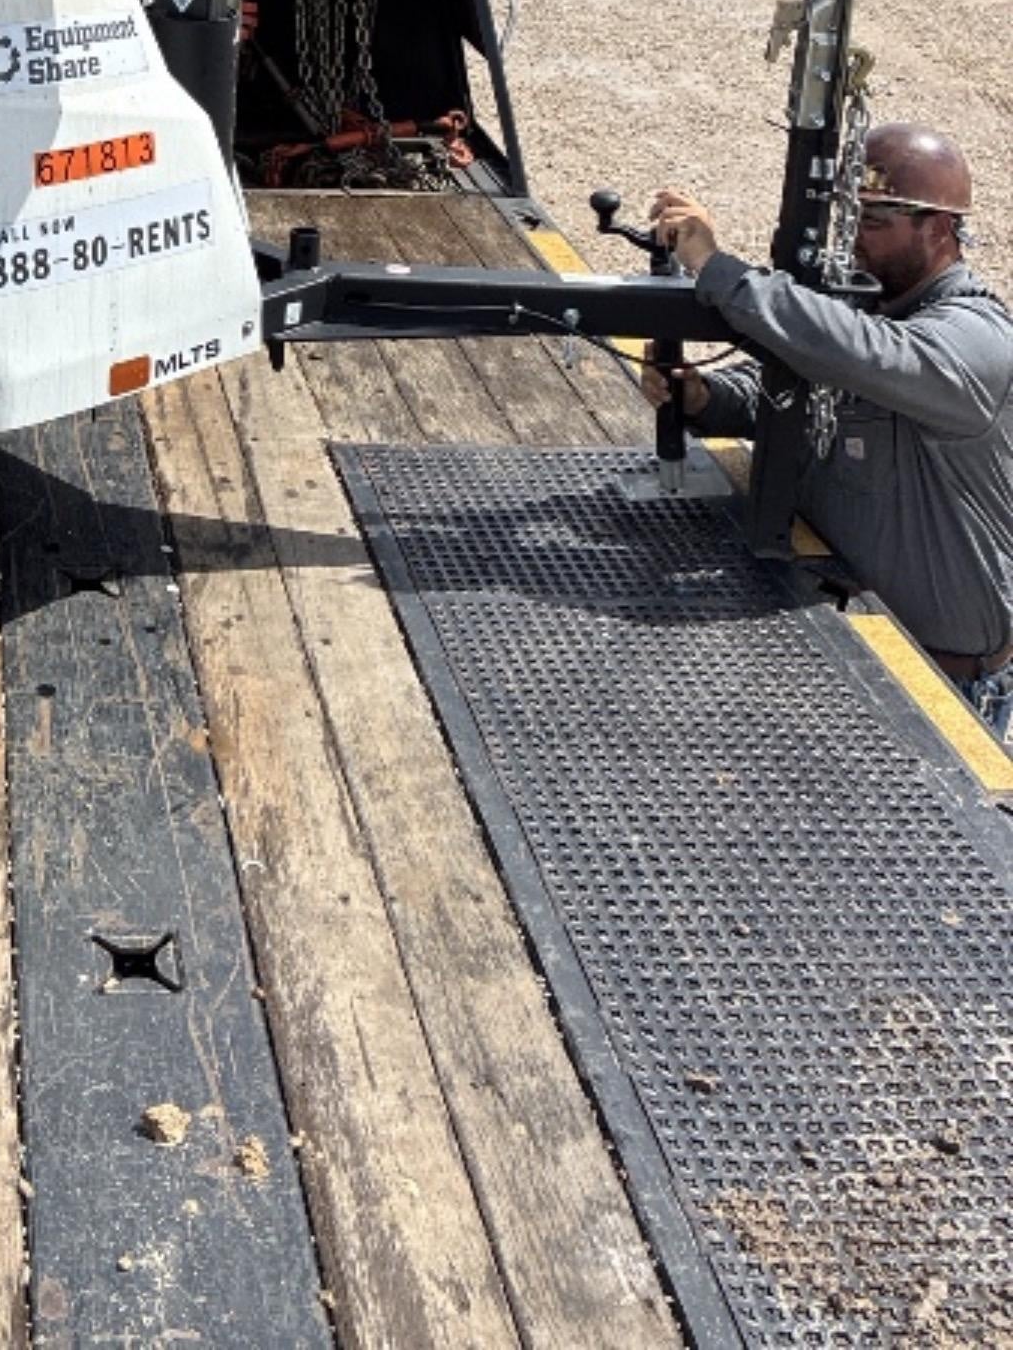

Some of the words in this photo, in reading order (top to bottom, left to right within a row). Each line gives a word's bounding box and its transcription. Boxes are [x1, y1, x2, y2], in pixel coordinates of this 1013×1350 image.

[24, 15, 138, 54] Equipment
[27, 55, 101, 84] Share
[38, 132, 154, 186] 671813
[154, 338, 221, 379] MLTS
